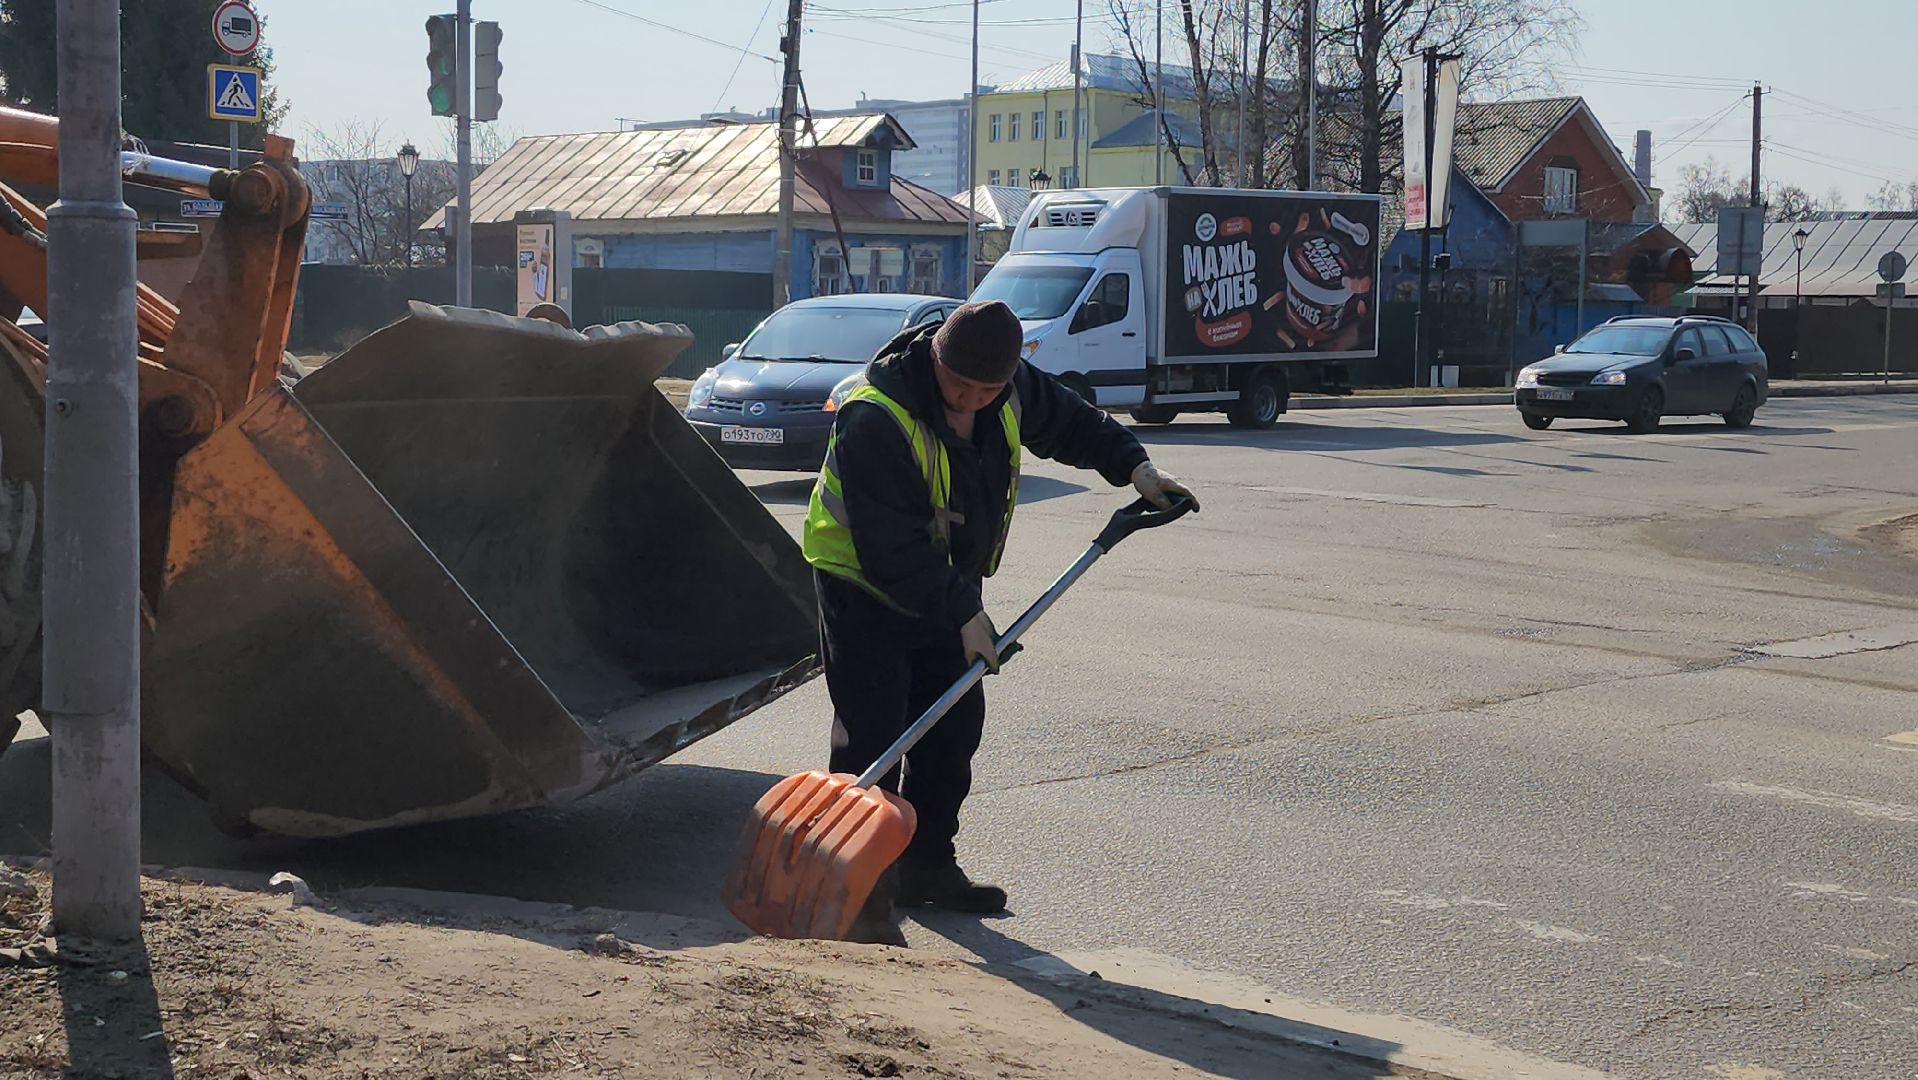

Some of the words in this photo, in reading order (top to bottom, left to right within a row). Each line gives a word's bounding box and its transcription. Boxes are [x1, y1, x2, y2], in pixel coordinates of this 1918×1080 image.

[1183, 240, 1256, 285] МАЖЬ
[1186, 291, 1202, 307] НА
[1200, 271, 1259, 318] ХЛЕБ
